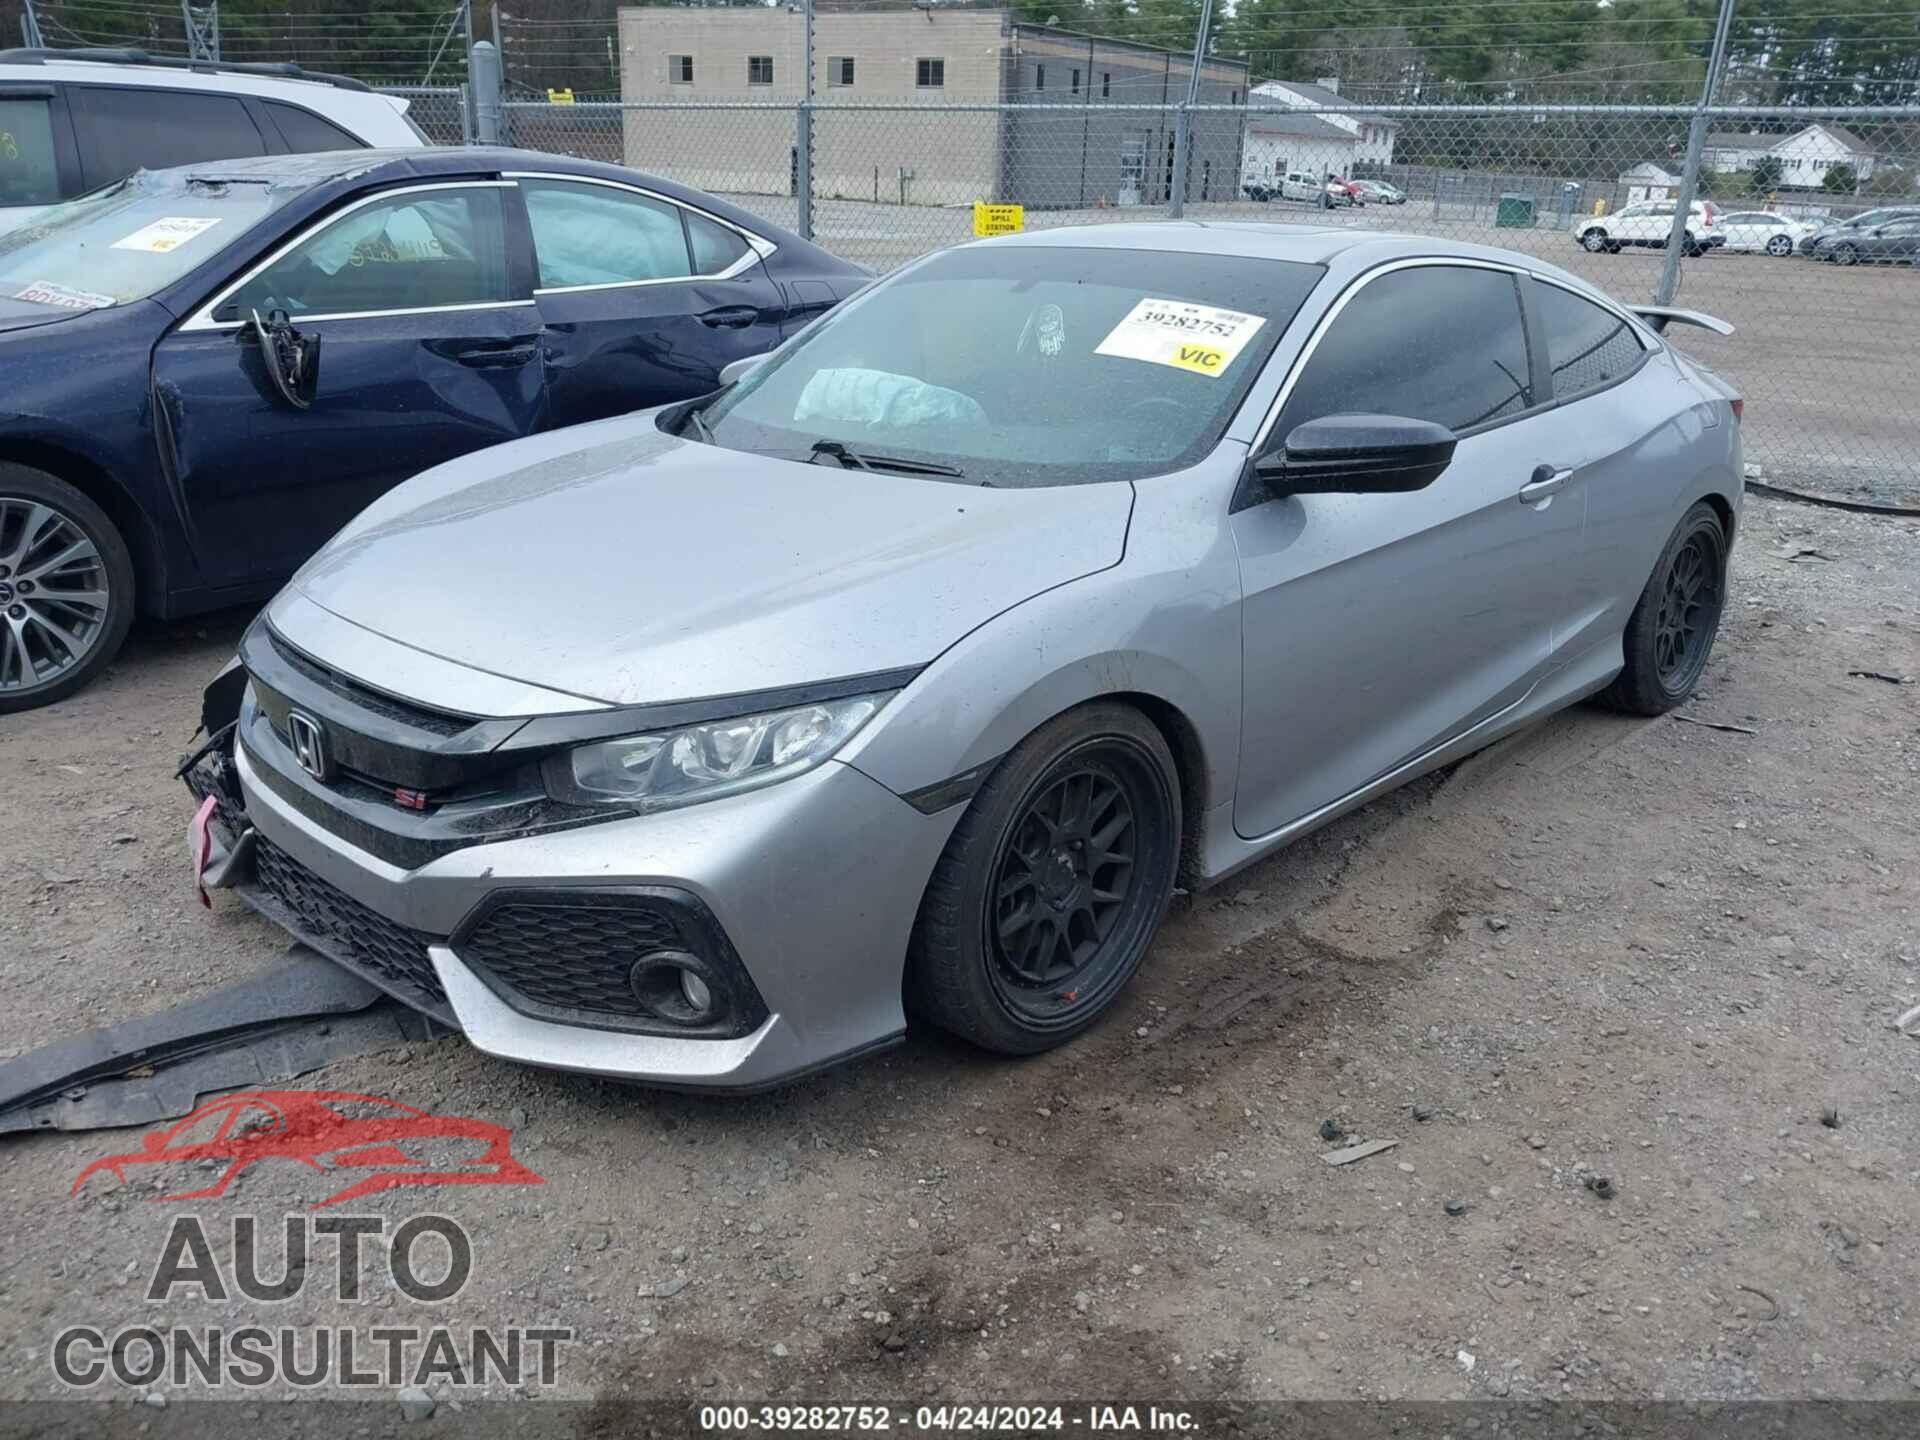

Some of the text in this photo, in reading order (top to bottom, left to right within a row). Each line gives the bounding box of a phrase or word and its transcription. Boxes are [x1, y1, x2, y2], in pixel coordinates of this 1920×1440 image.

[985, 223, 1016, 231] STATION
[1137, 311, 1237, 338] 39282752
[1178, 346, 1221, 368] VIC
